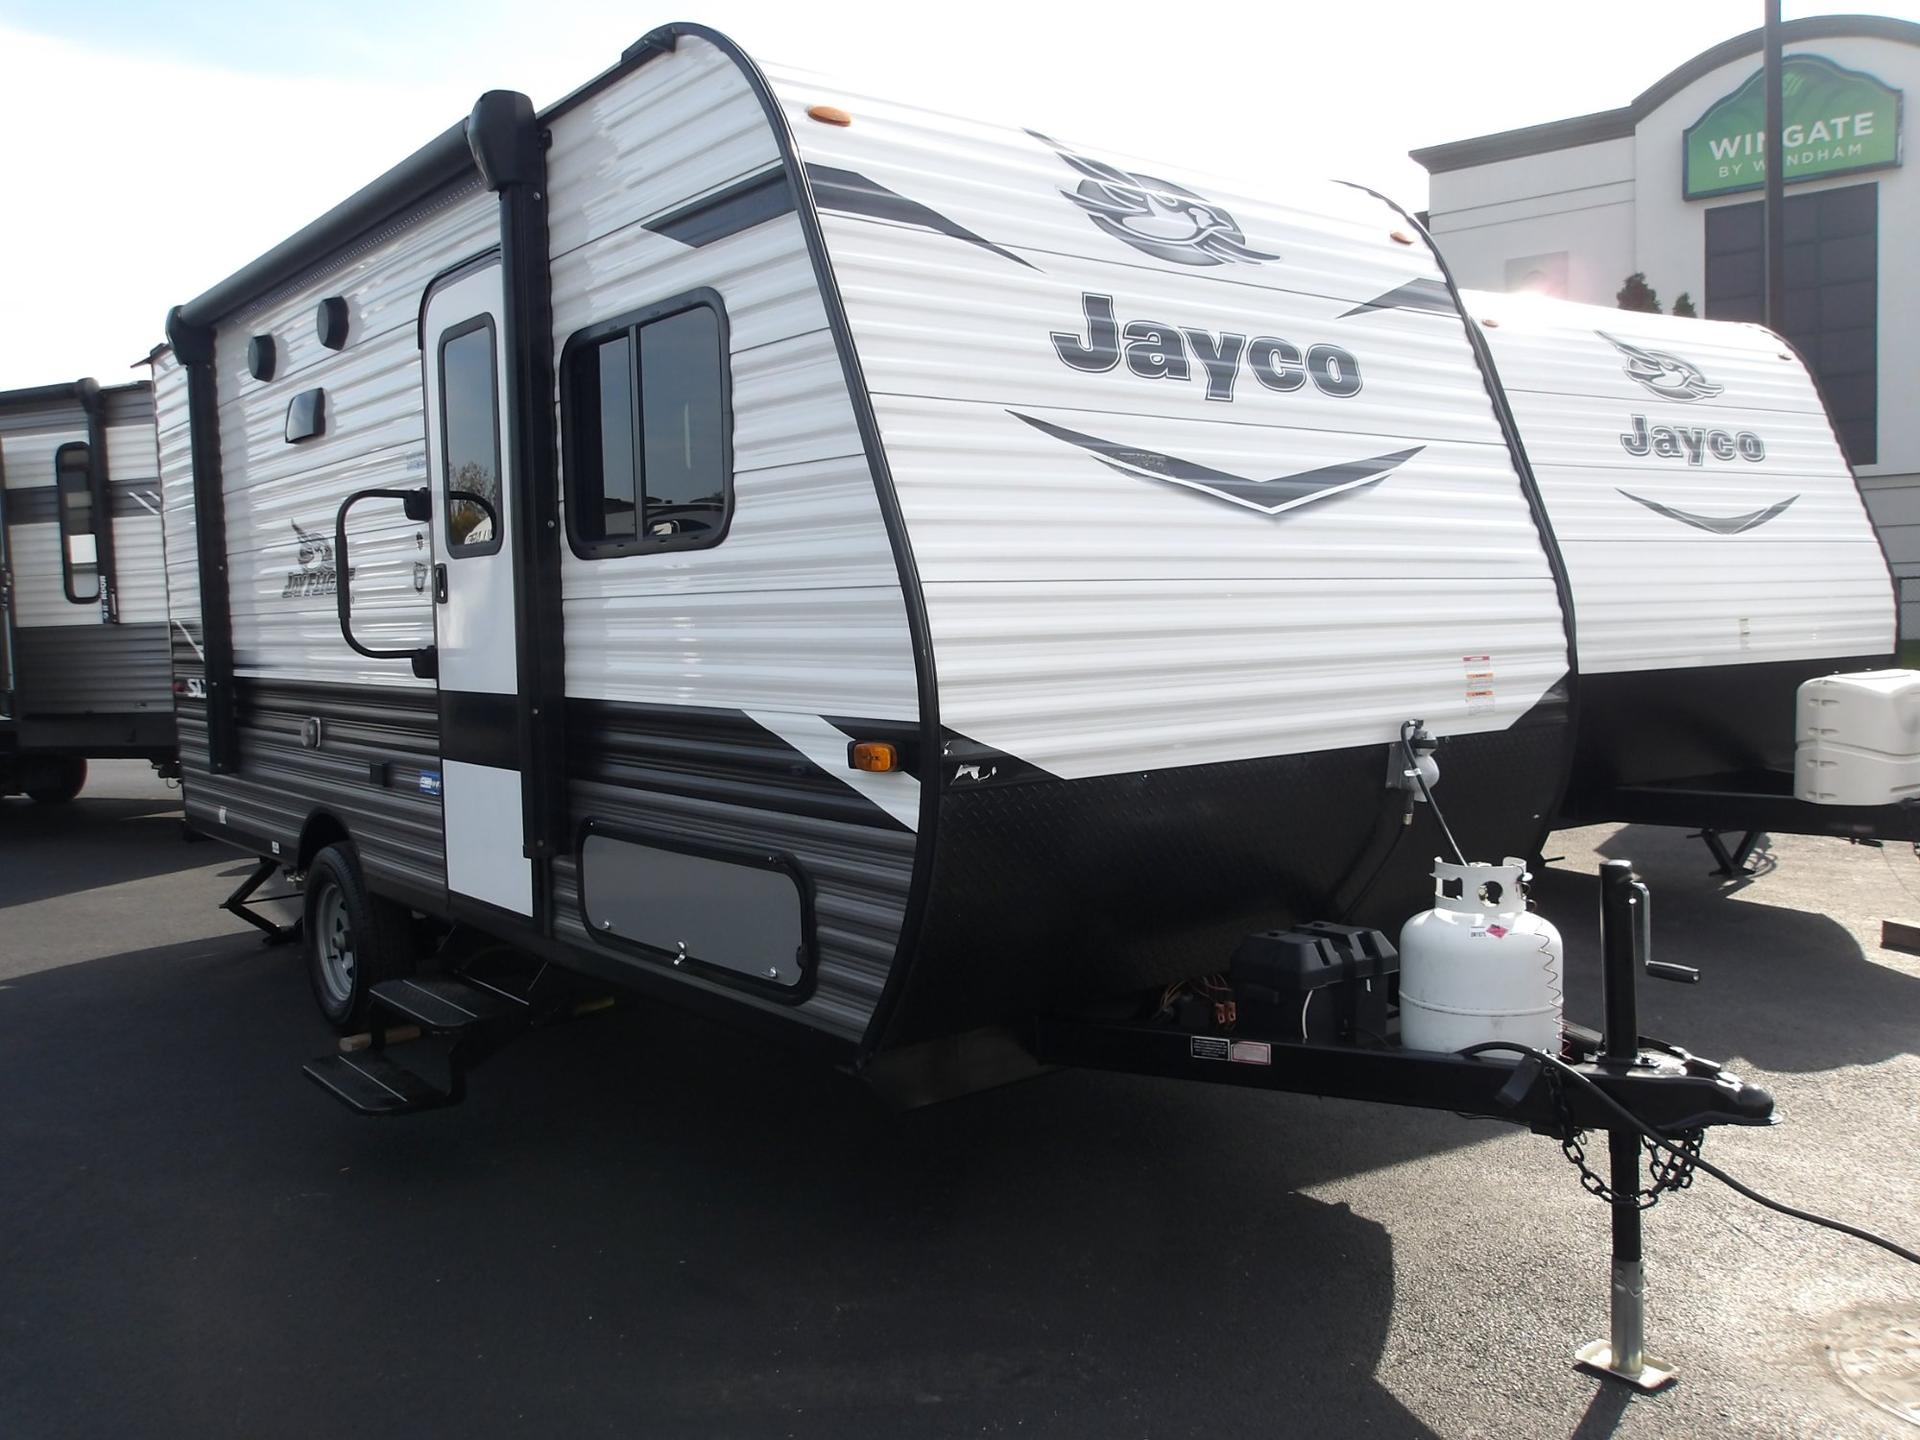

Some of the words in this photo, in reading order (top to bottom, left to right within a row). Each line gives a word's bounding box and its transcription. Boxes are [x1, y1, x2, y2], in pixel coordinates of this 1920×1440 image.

[1718, 164, 1743, 178] BY
[1753, 144, 1863, 171] WNDHAM
[1049, 291, 1363, 403] Jayco
[1620, 414, 1766, 466] Jayco
[187, 678, 208, 698] SL
